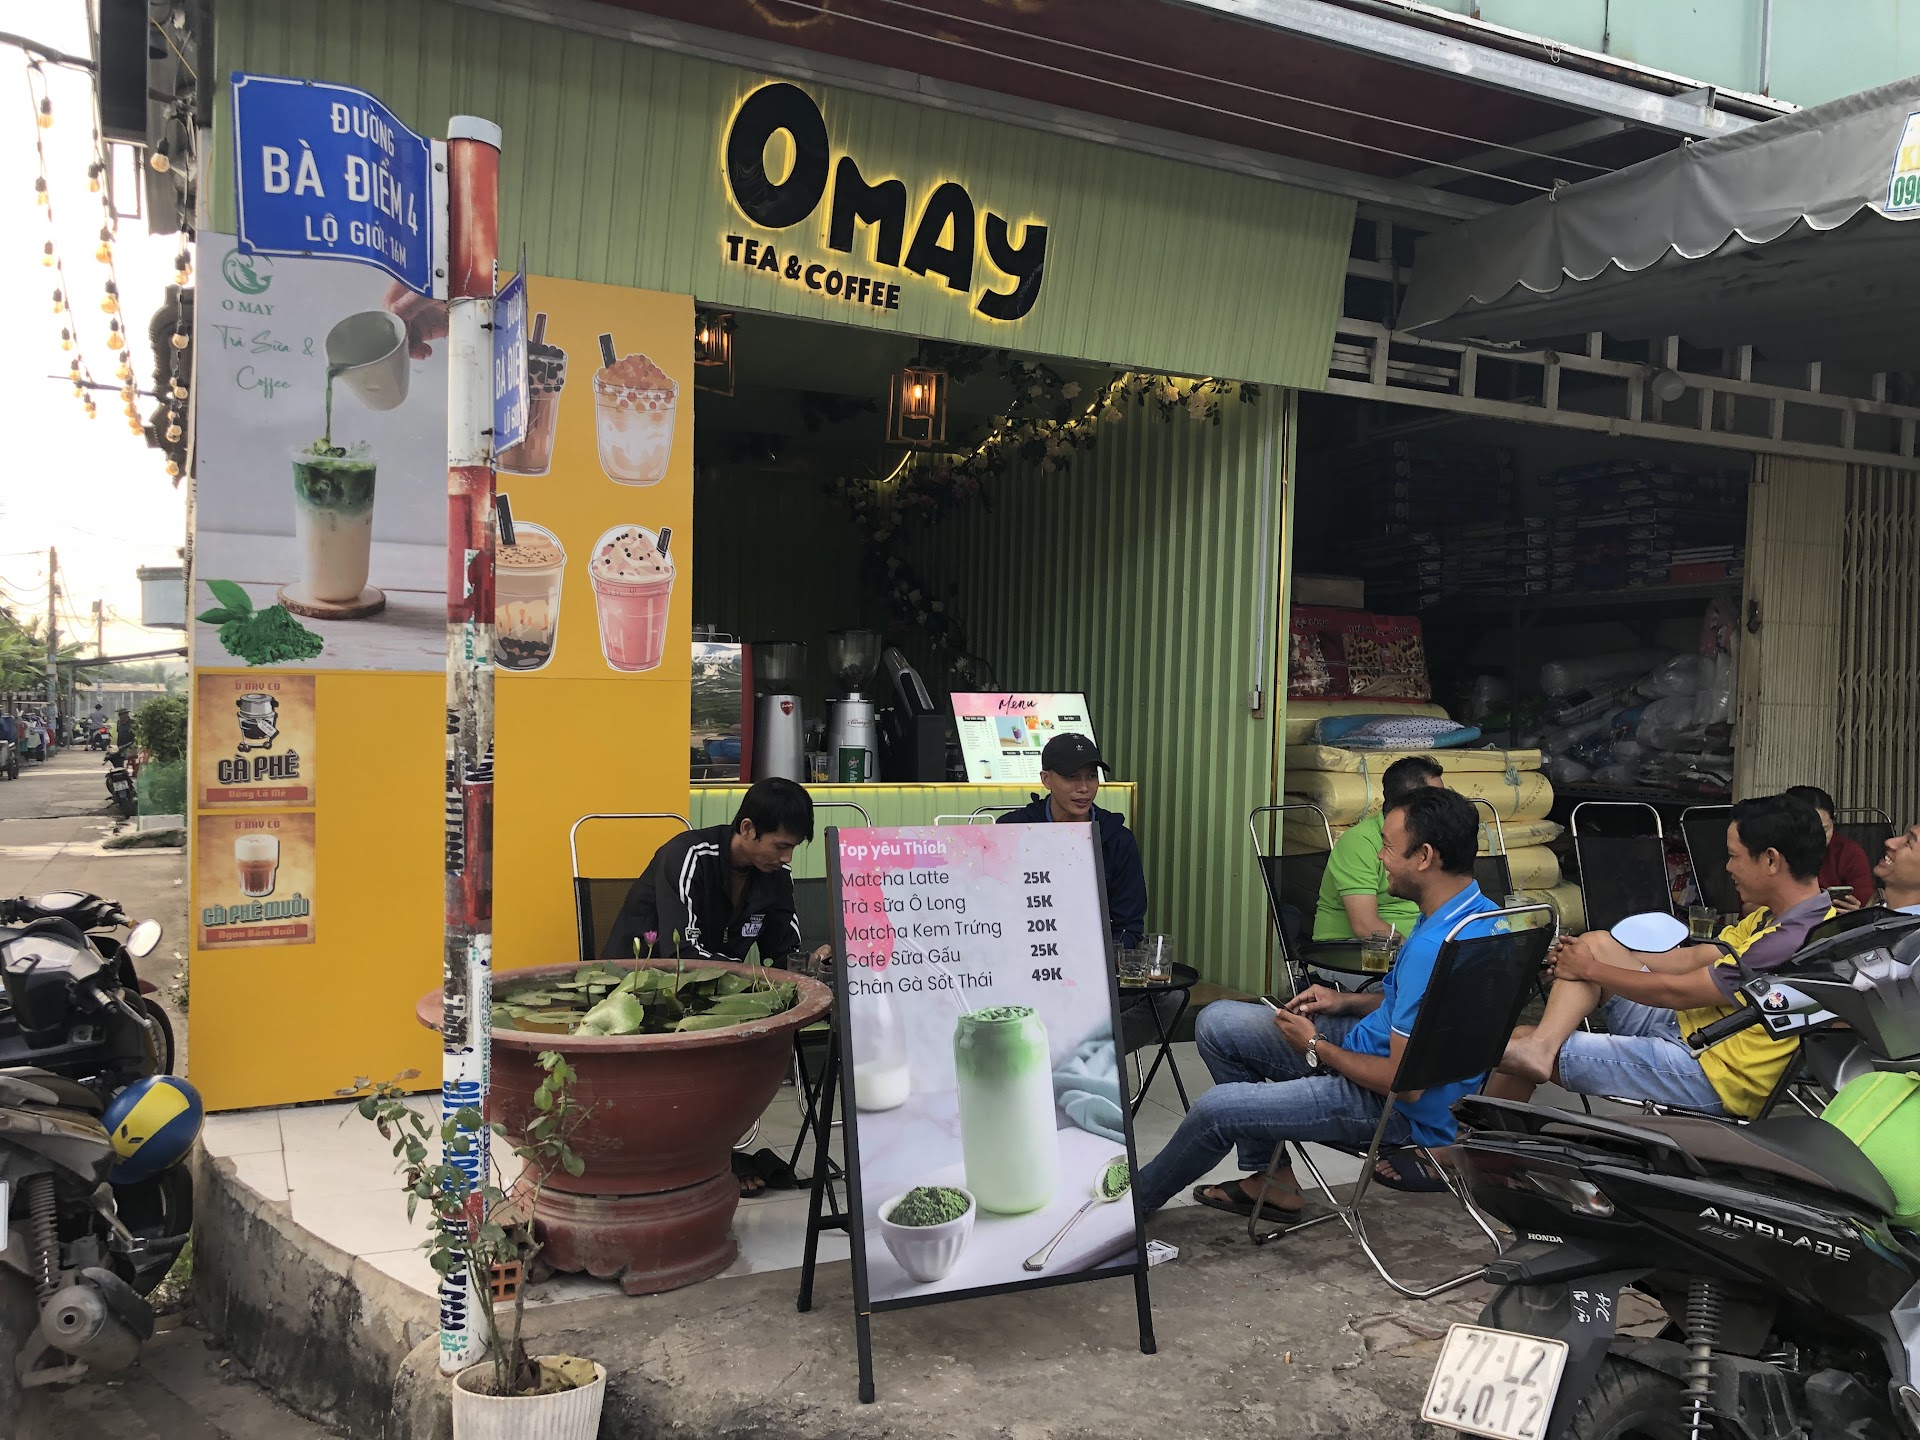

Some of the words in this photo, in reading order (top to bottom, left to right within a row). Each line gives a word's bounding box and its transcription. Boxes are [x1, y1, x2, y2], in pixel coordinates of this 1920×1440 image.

[329, 101, 395, 157] ĐƯỜNG
[262, 138, 325, 198] BÀ
[344, 154, 403, 226] ĐIỂM
[407, 192, 418, 237] 4
[305, 212, 339, 248] LỘ
[390, 235, 407, 269] 16M
[726, 234, 779, 273] TEA
[784, 255, 803, 281] &
[805, 264, 901, 310] COFFEE
[222, 299, 234, 311] O
[238, 301, 275, 316] MAY
[303, 336, 314, 358] &
[237, 365, 292, 399] Coffee
[998, 694, 1038, 715] Menu
[218, 753, 251, 785] CÀ
[253, 748, 300, 781] PHÊ
[839, 840, 869, 860] Top
[871, 841, 900, 861] yêu
[903, 839, 947, 855] Thích
[841, 871, 904, 887] Matcha
[909, 870, 950, 886] Latte
[1023, 870, 1051, 884] 25K
[202, 904, 227, 927] CÀ
[229, 899, 263, 924] PHÊ
[264, 892, 310, 920] MUỐI
[841, 897, 868, 914] Trà
[874, 897, 905, 912] sữa
[909, 895, 922, 911] Ô
[927, 896, 966, 914] Long
[1026, 894, 1053, 908] 15K
[844, 924, 908, 941] Matcha
[913, 923, 950, 939] Kem
[954, 919, 1002, 938] Trứng
[1027, 918, 1057, 933] 20K
[891, 950, 923, 966] Sữa
[928, 945, 961, 964] Gấu
[1030, 943, 1059, 957] 25K
[847, 977, 893, 996] Chân
[898, 976, 923, 993] Gà
[928, 972, 954, 990] Sốt
[958, 972, 993, 988] Thái
[1031, 967, 1062, 982] 49K
[1527, 1232, 1564, 1244] HONDA
[1699, 1206, 1851, 1262] AIRBLADE
[1432, 1374, 1544, 1438] 340.12
